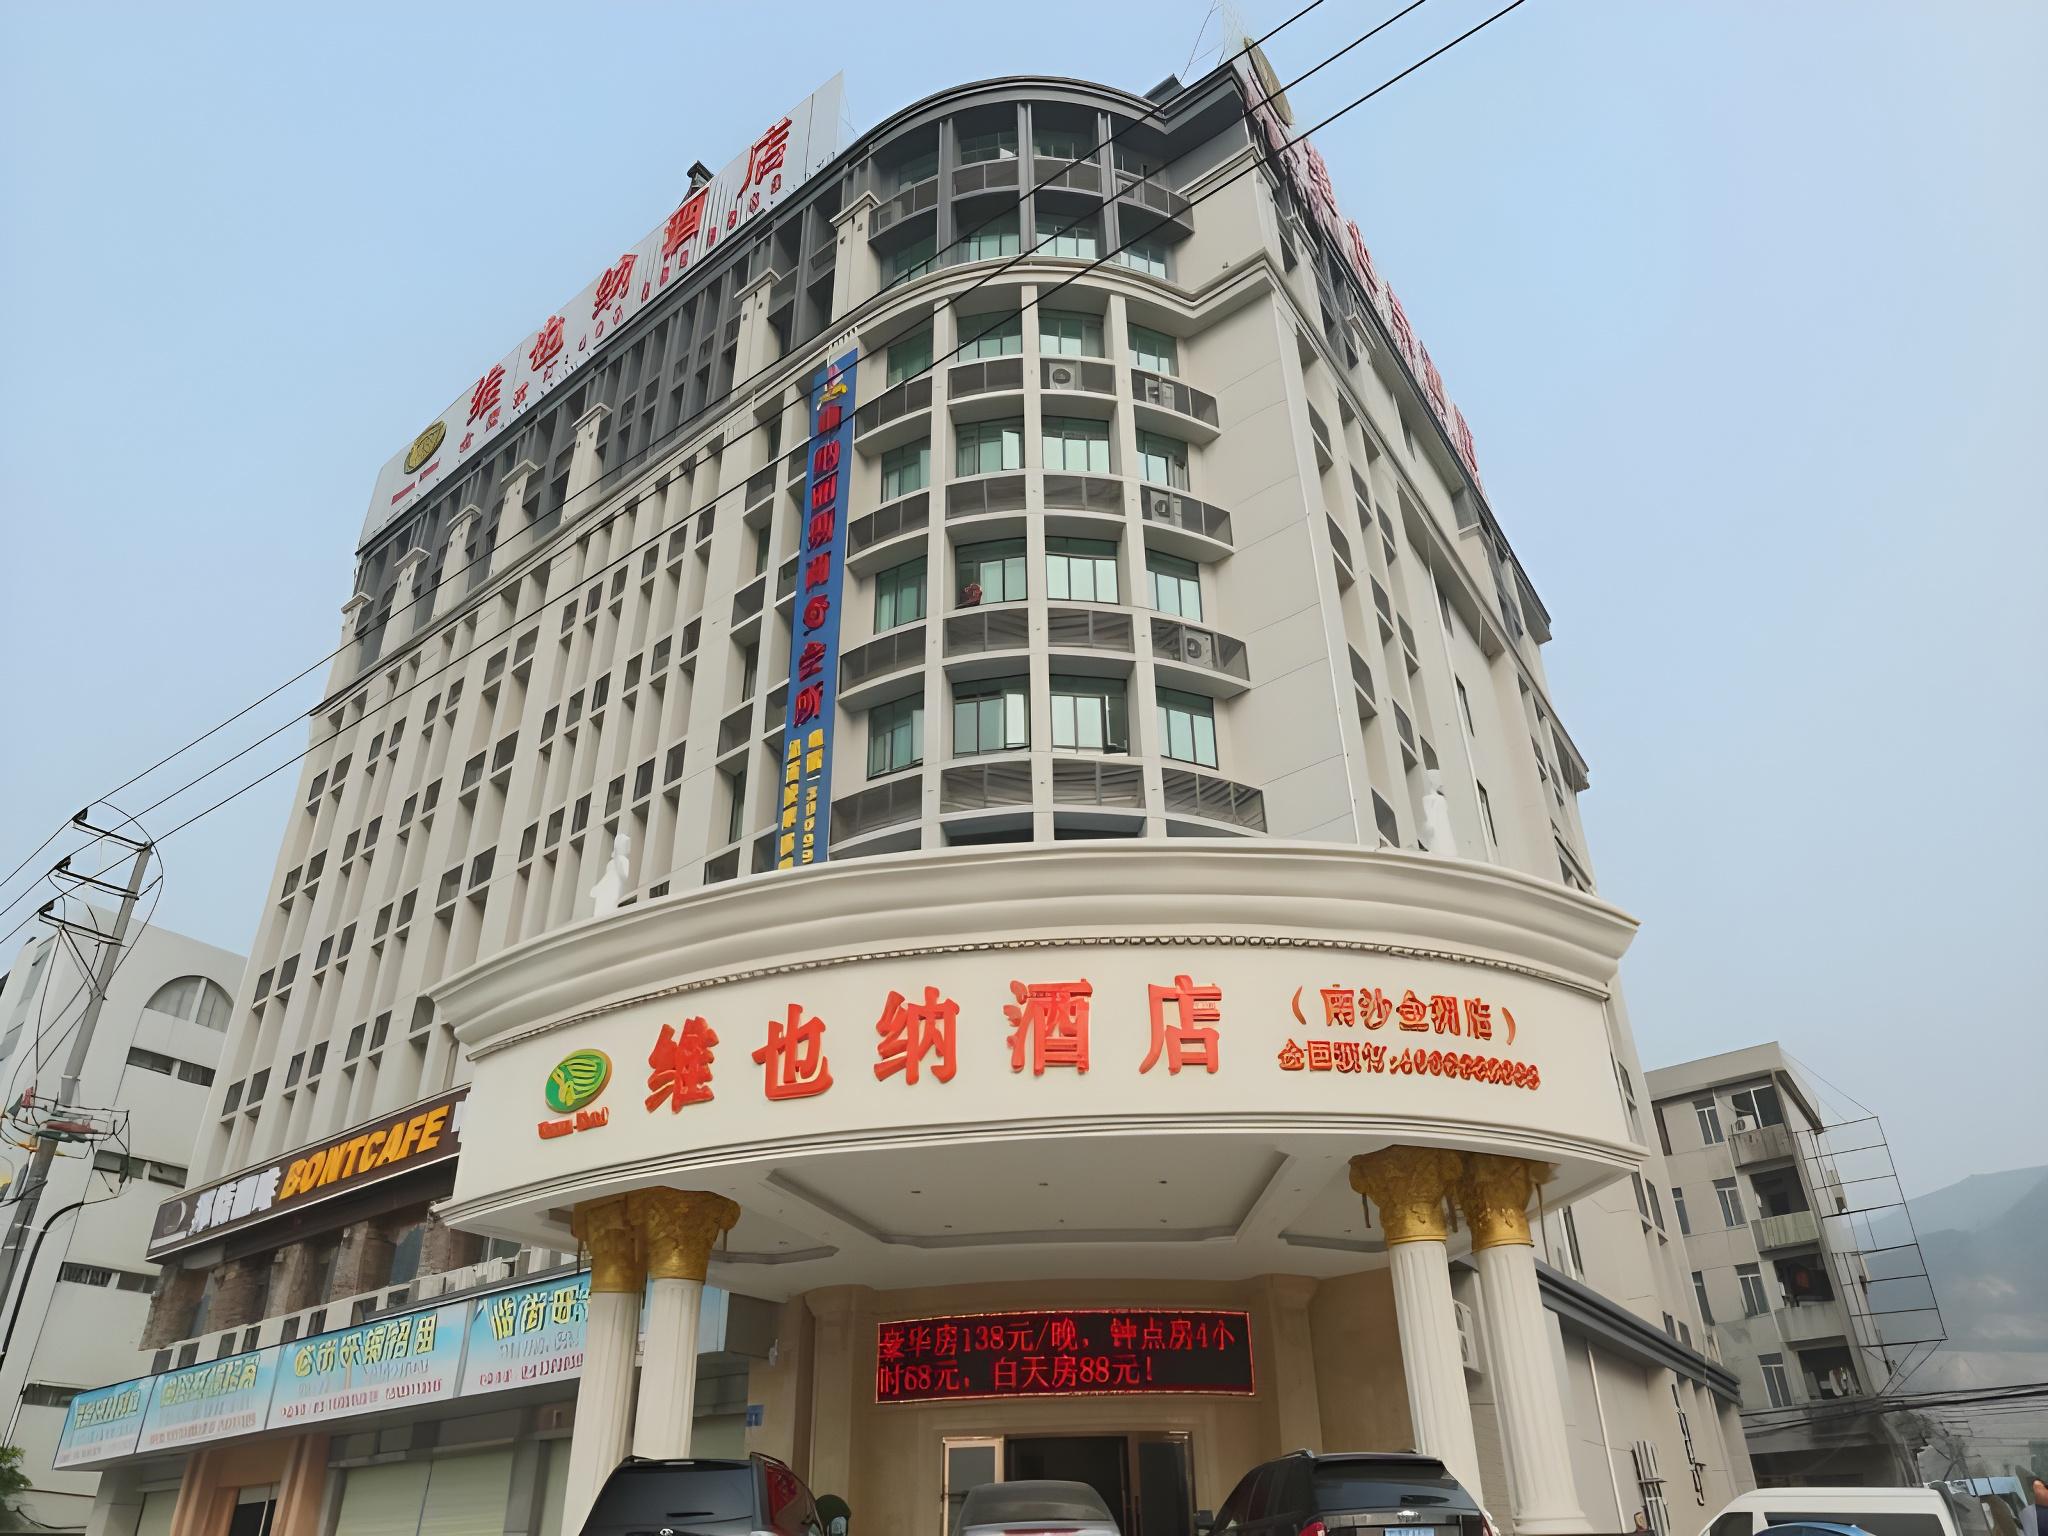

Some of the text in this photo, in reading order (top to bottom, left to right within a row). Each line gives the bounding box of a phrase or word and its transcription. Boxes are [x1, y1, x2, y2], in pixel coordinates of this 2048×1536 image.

[467, 117, 792, 427] 维也纳酒店
[644, 974, 1223, 1114] 维也纳酒店
